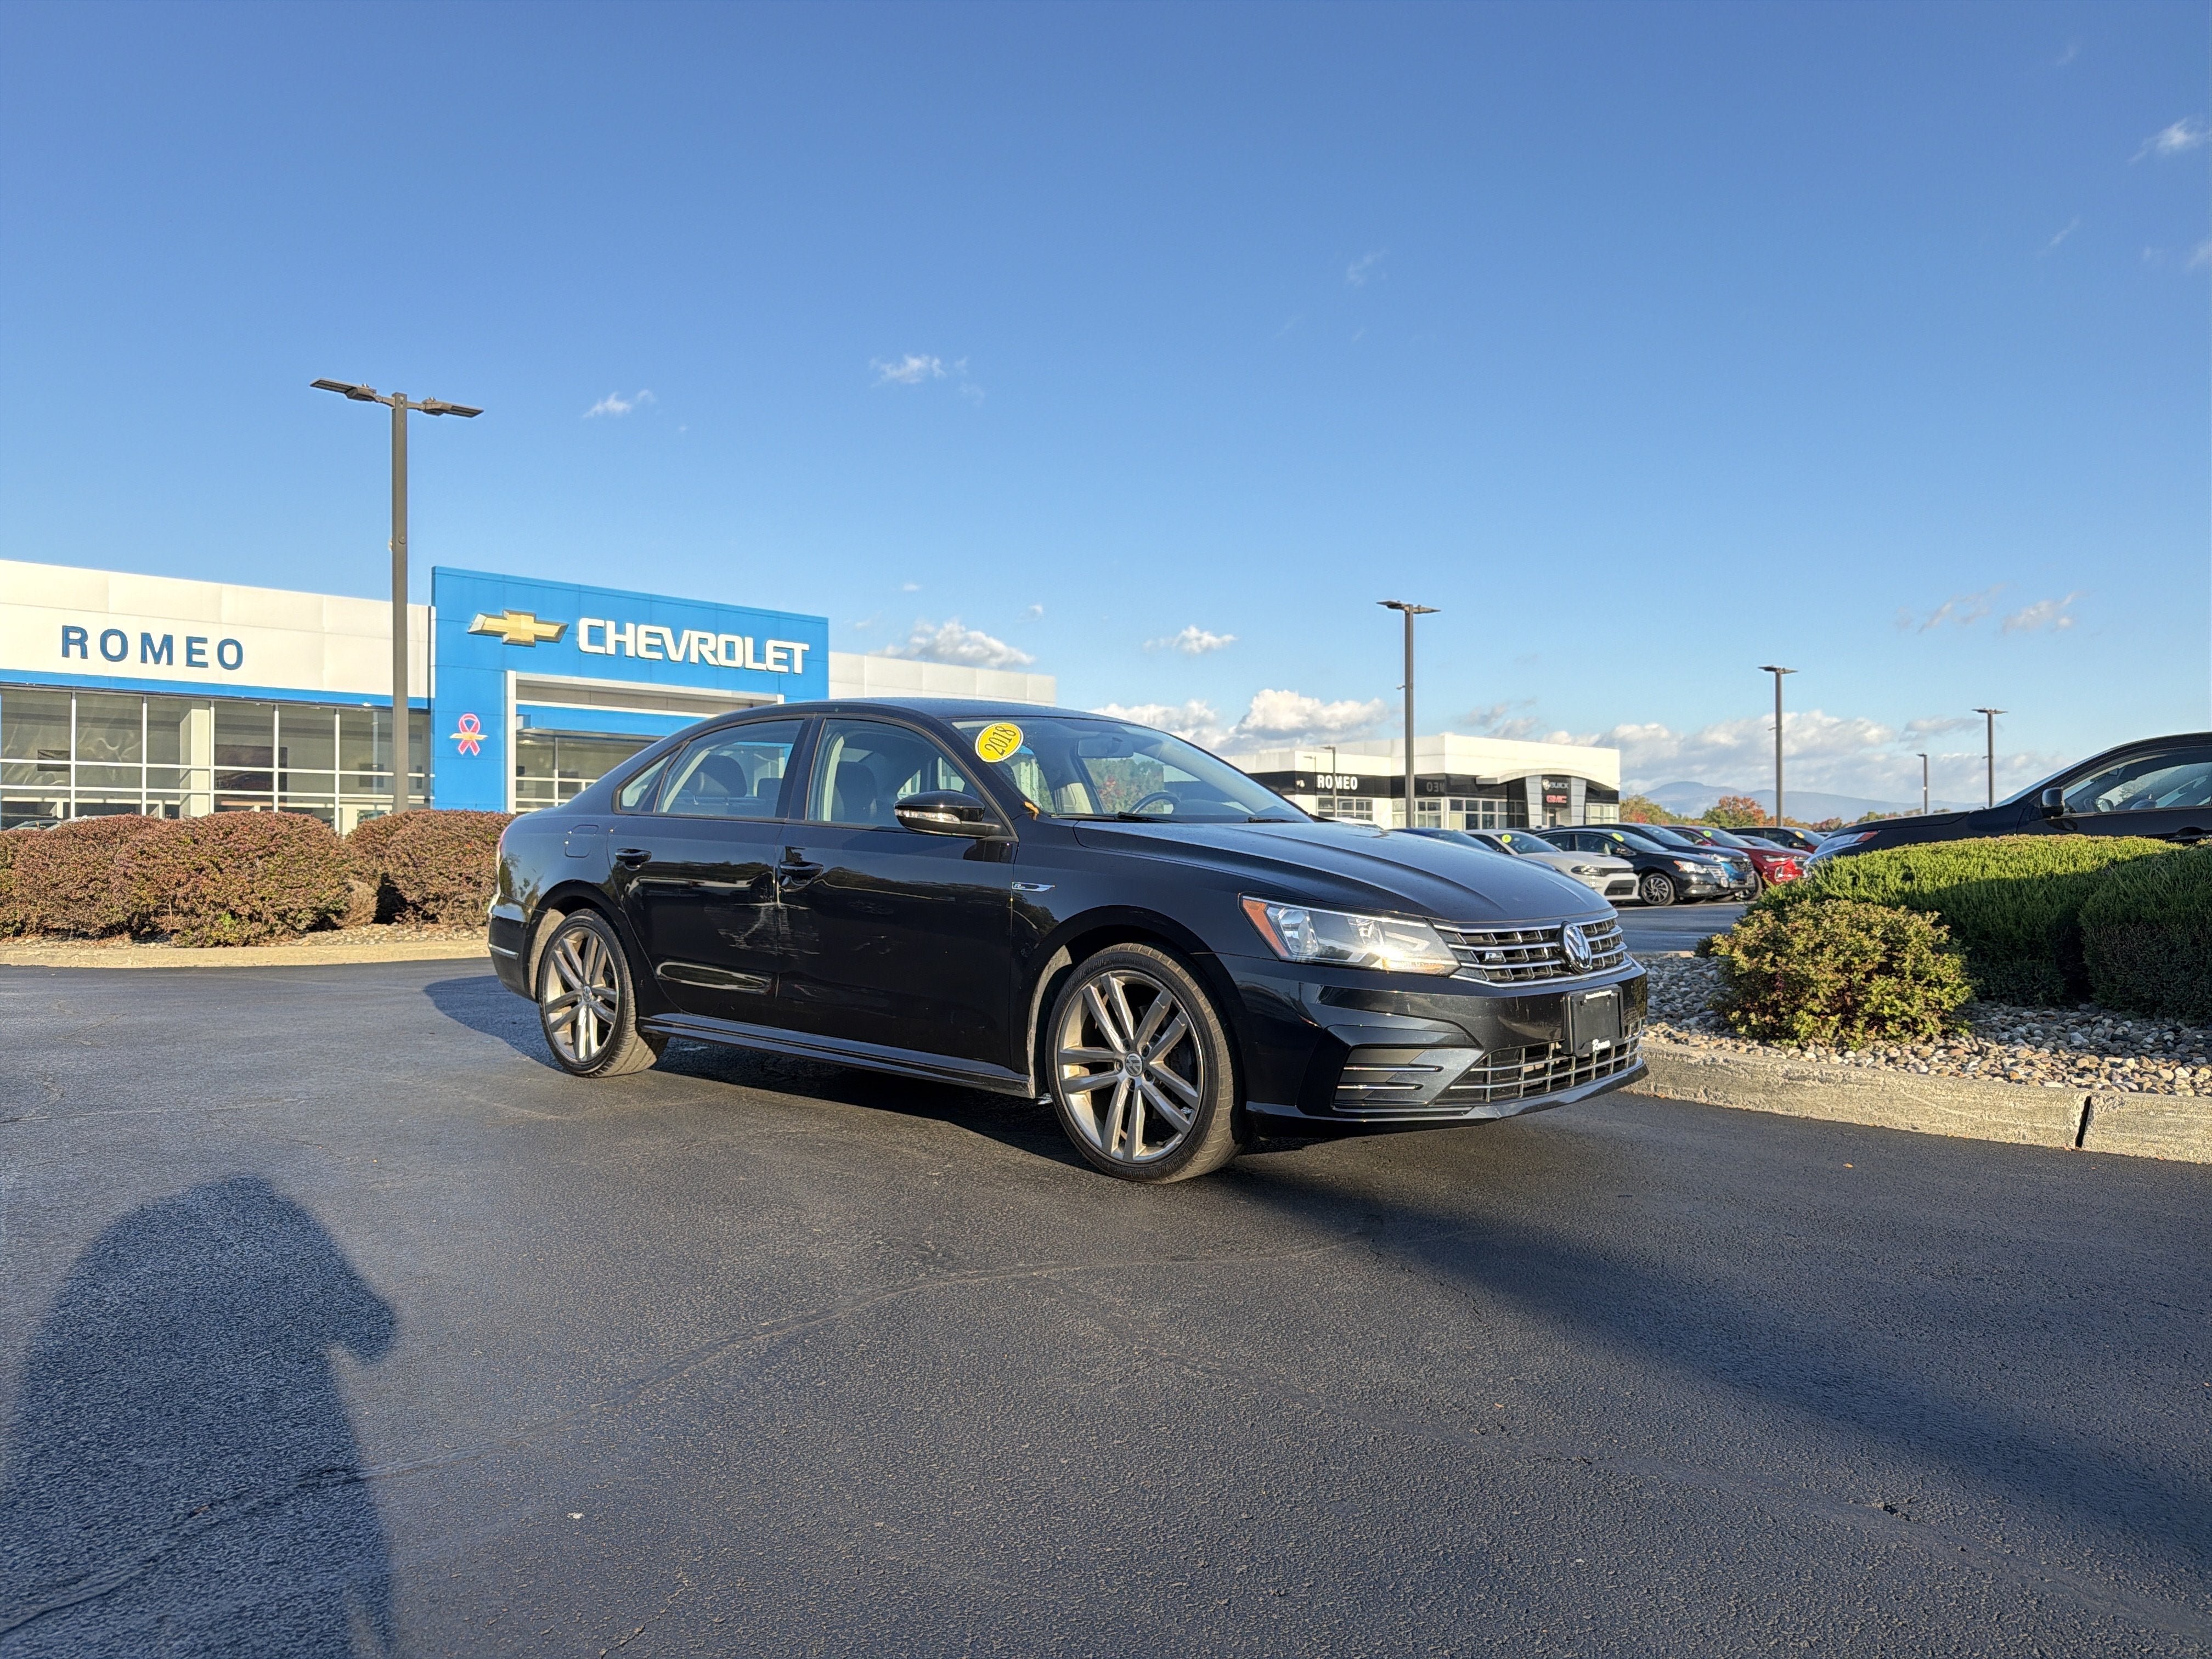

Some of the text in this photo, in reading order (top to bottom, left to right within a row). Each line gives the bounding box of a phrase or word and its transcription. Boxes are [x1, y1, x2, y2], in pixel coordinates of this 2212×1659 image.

[61, 625, 244, 670] ROMEO
[578, 617, 810, 675] CHEVROLET
[984, 726, 1017, 756] 2018
[1317, 775, 1358, 790] ROMEO
[1546, 794, 1567, 804] GMC
